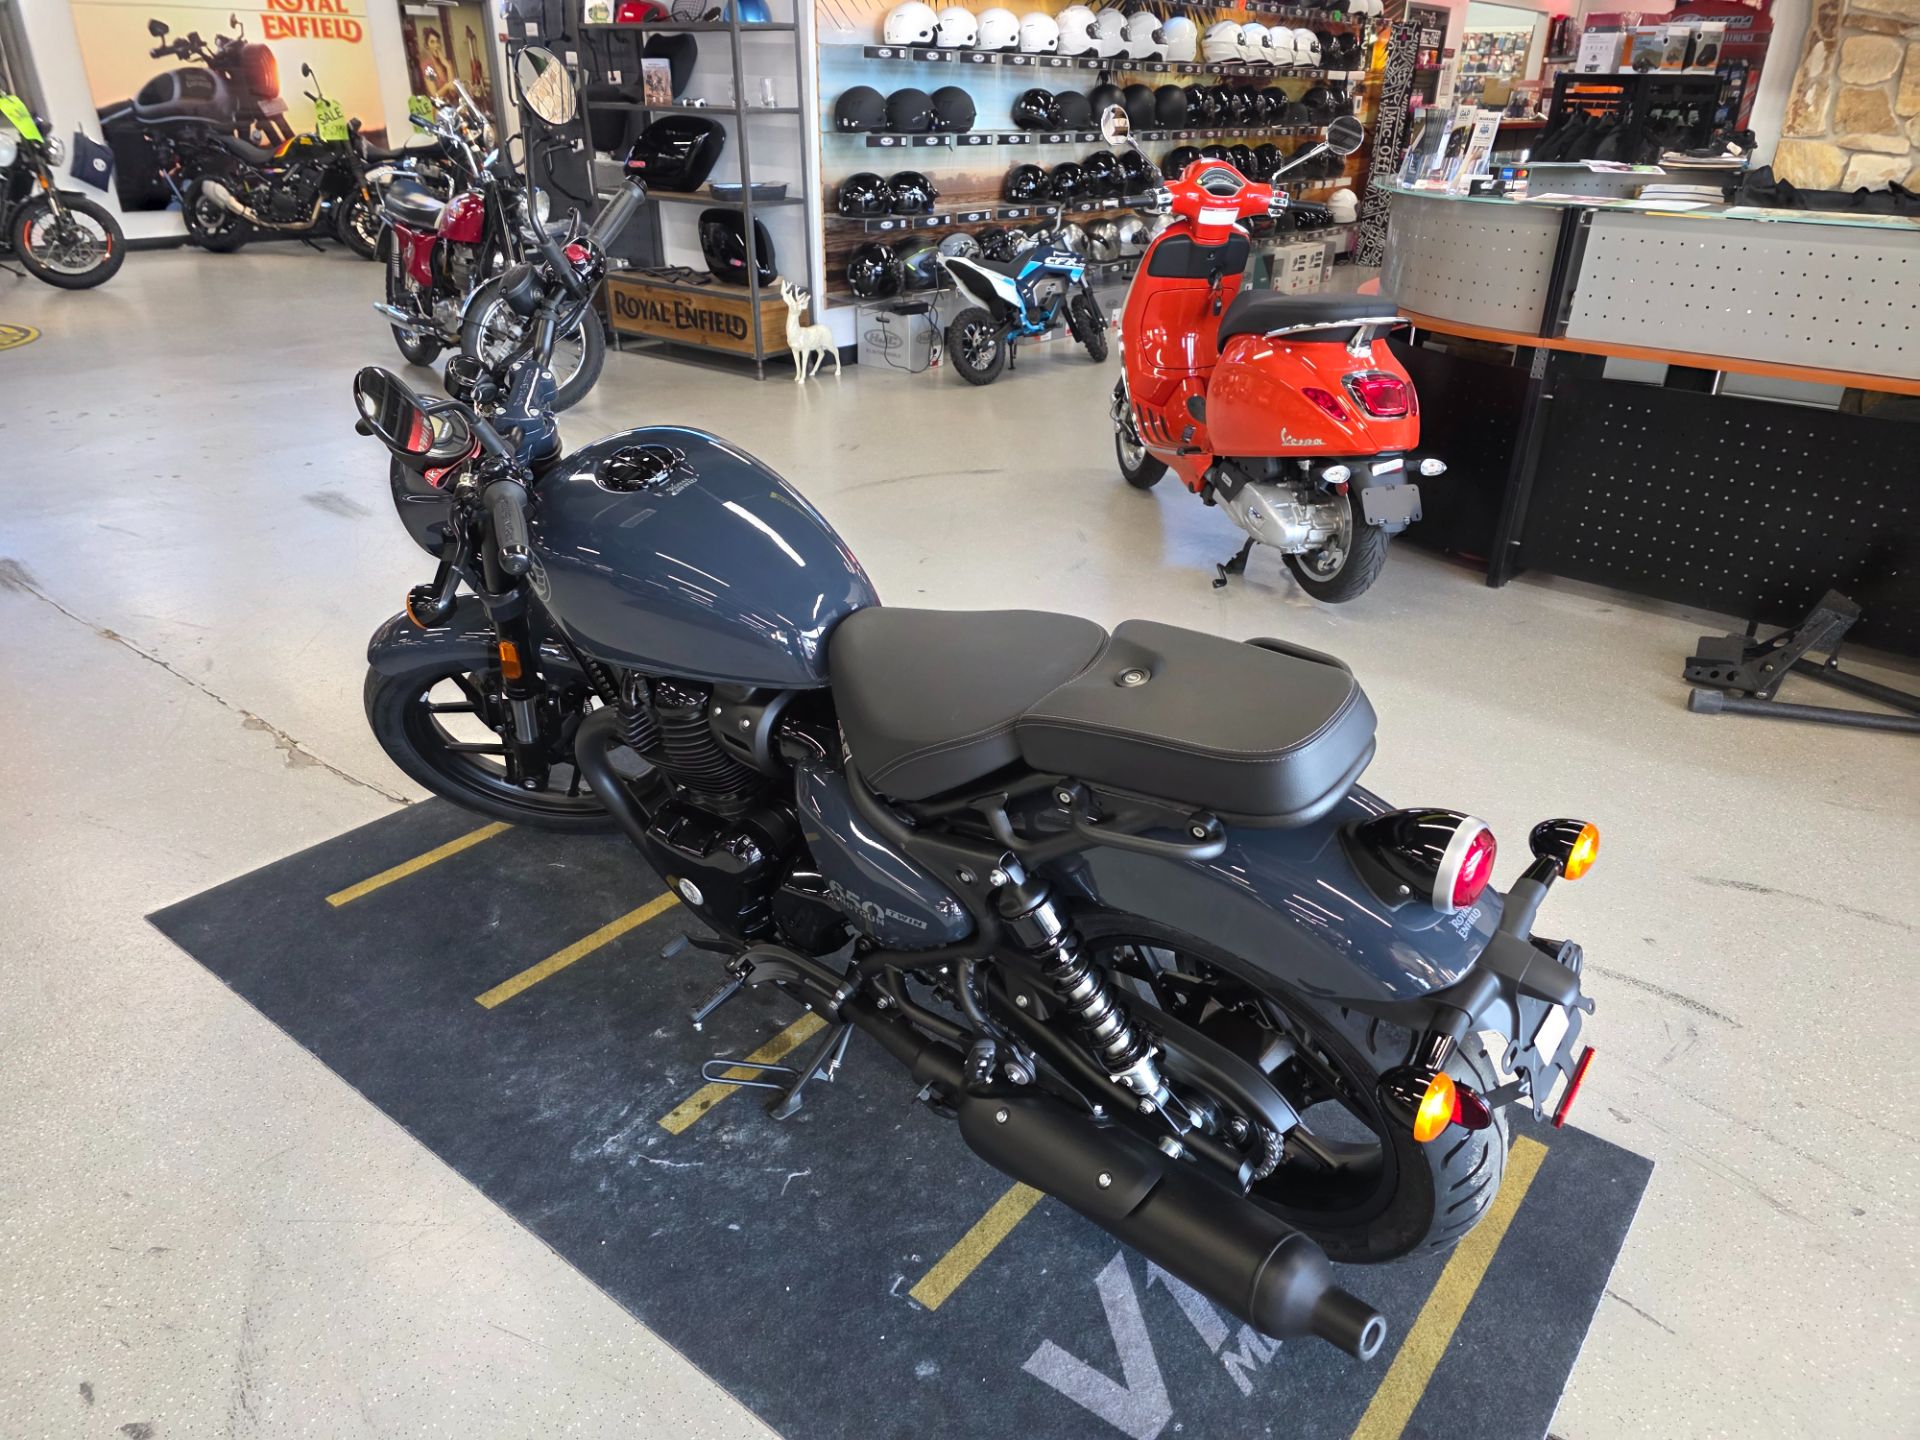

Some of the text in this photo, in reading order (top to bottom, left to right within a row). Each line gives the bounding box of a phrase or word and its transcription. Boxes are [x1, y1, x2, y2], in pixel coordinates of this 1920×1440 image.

[261, 14, 362, 43] ENFIELD
[317, 107, 344, 125] SALE
[1377, 110, 1397, 173] Muc-Off
[614, 290, 748, 340] ROYAL ENFIELD
[1281, 427, 1327, 447] Vespa
[887, 908, 927, 929] TWIN
[1449, 906, 1472, 928] ROYAL
[1456, 908, 1481, 941] ENFIELD
